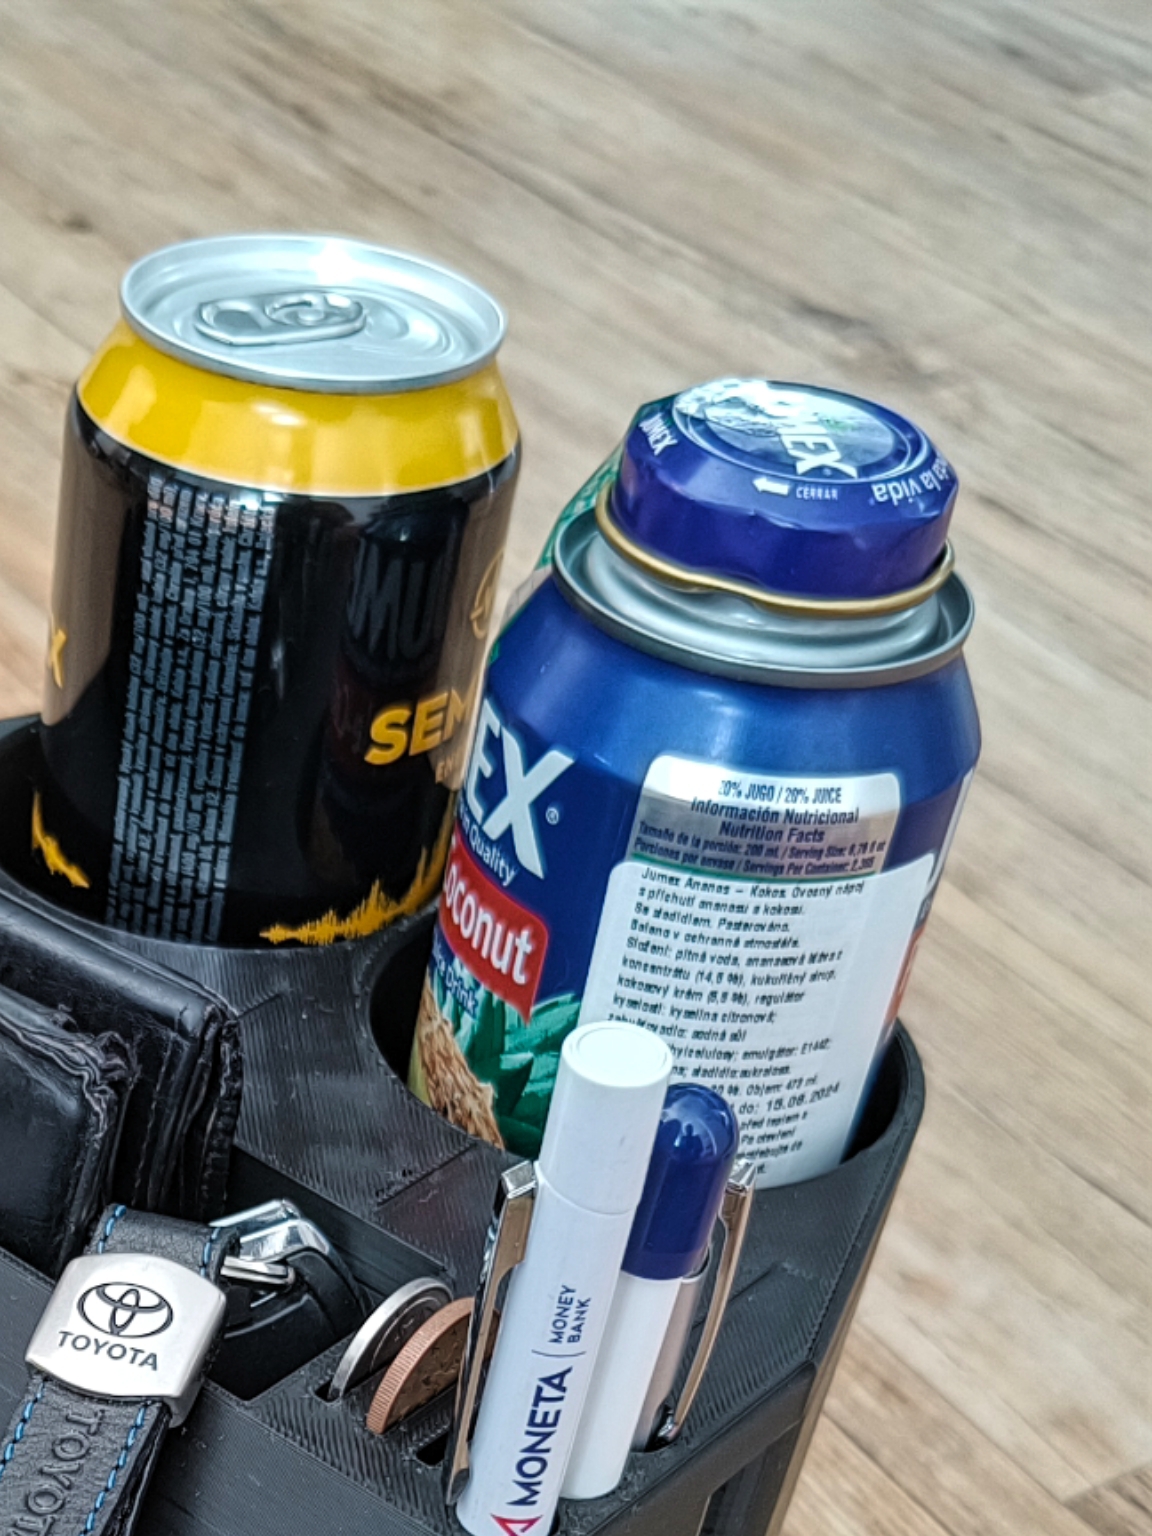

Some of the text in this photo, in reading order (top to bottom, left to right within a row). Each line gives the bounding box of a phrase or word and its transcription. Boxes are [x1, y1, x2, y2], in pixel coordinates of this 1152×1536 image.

[795, 485, 838, 500] CERRAR
[871, 477, 922, 506] vida
[691, 796, 859, 826] Información Nutricional
[745, 783, 775, 802] JUGO
[812, 787, 842, 804] JUICE
[719, 820, 826, 843] Nutrition Facts
[469, 823, 516, 887] Quality
[443, 863, 534, 986] oconut
[548, 1284, 576, 1344] MONEY
[567, 1297, 591, 1343] BANK
[58, 1330, 159, 1372] TOYOTA
[506, 1366, 573, 1507] MONETA
